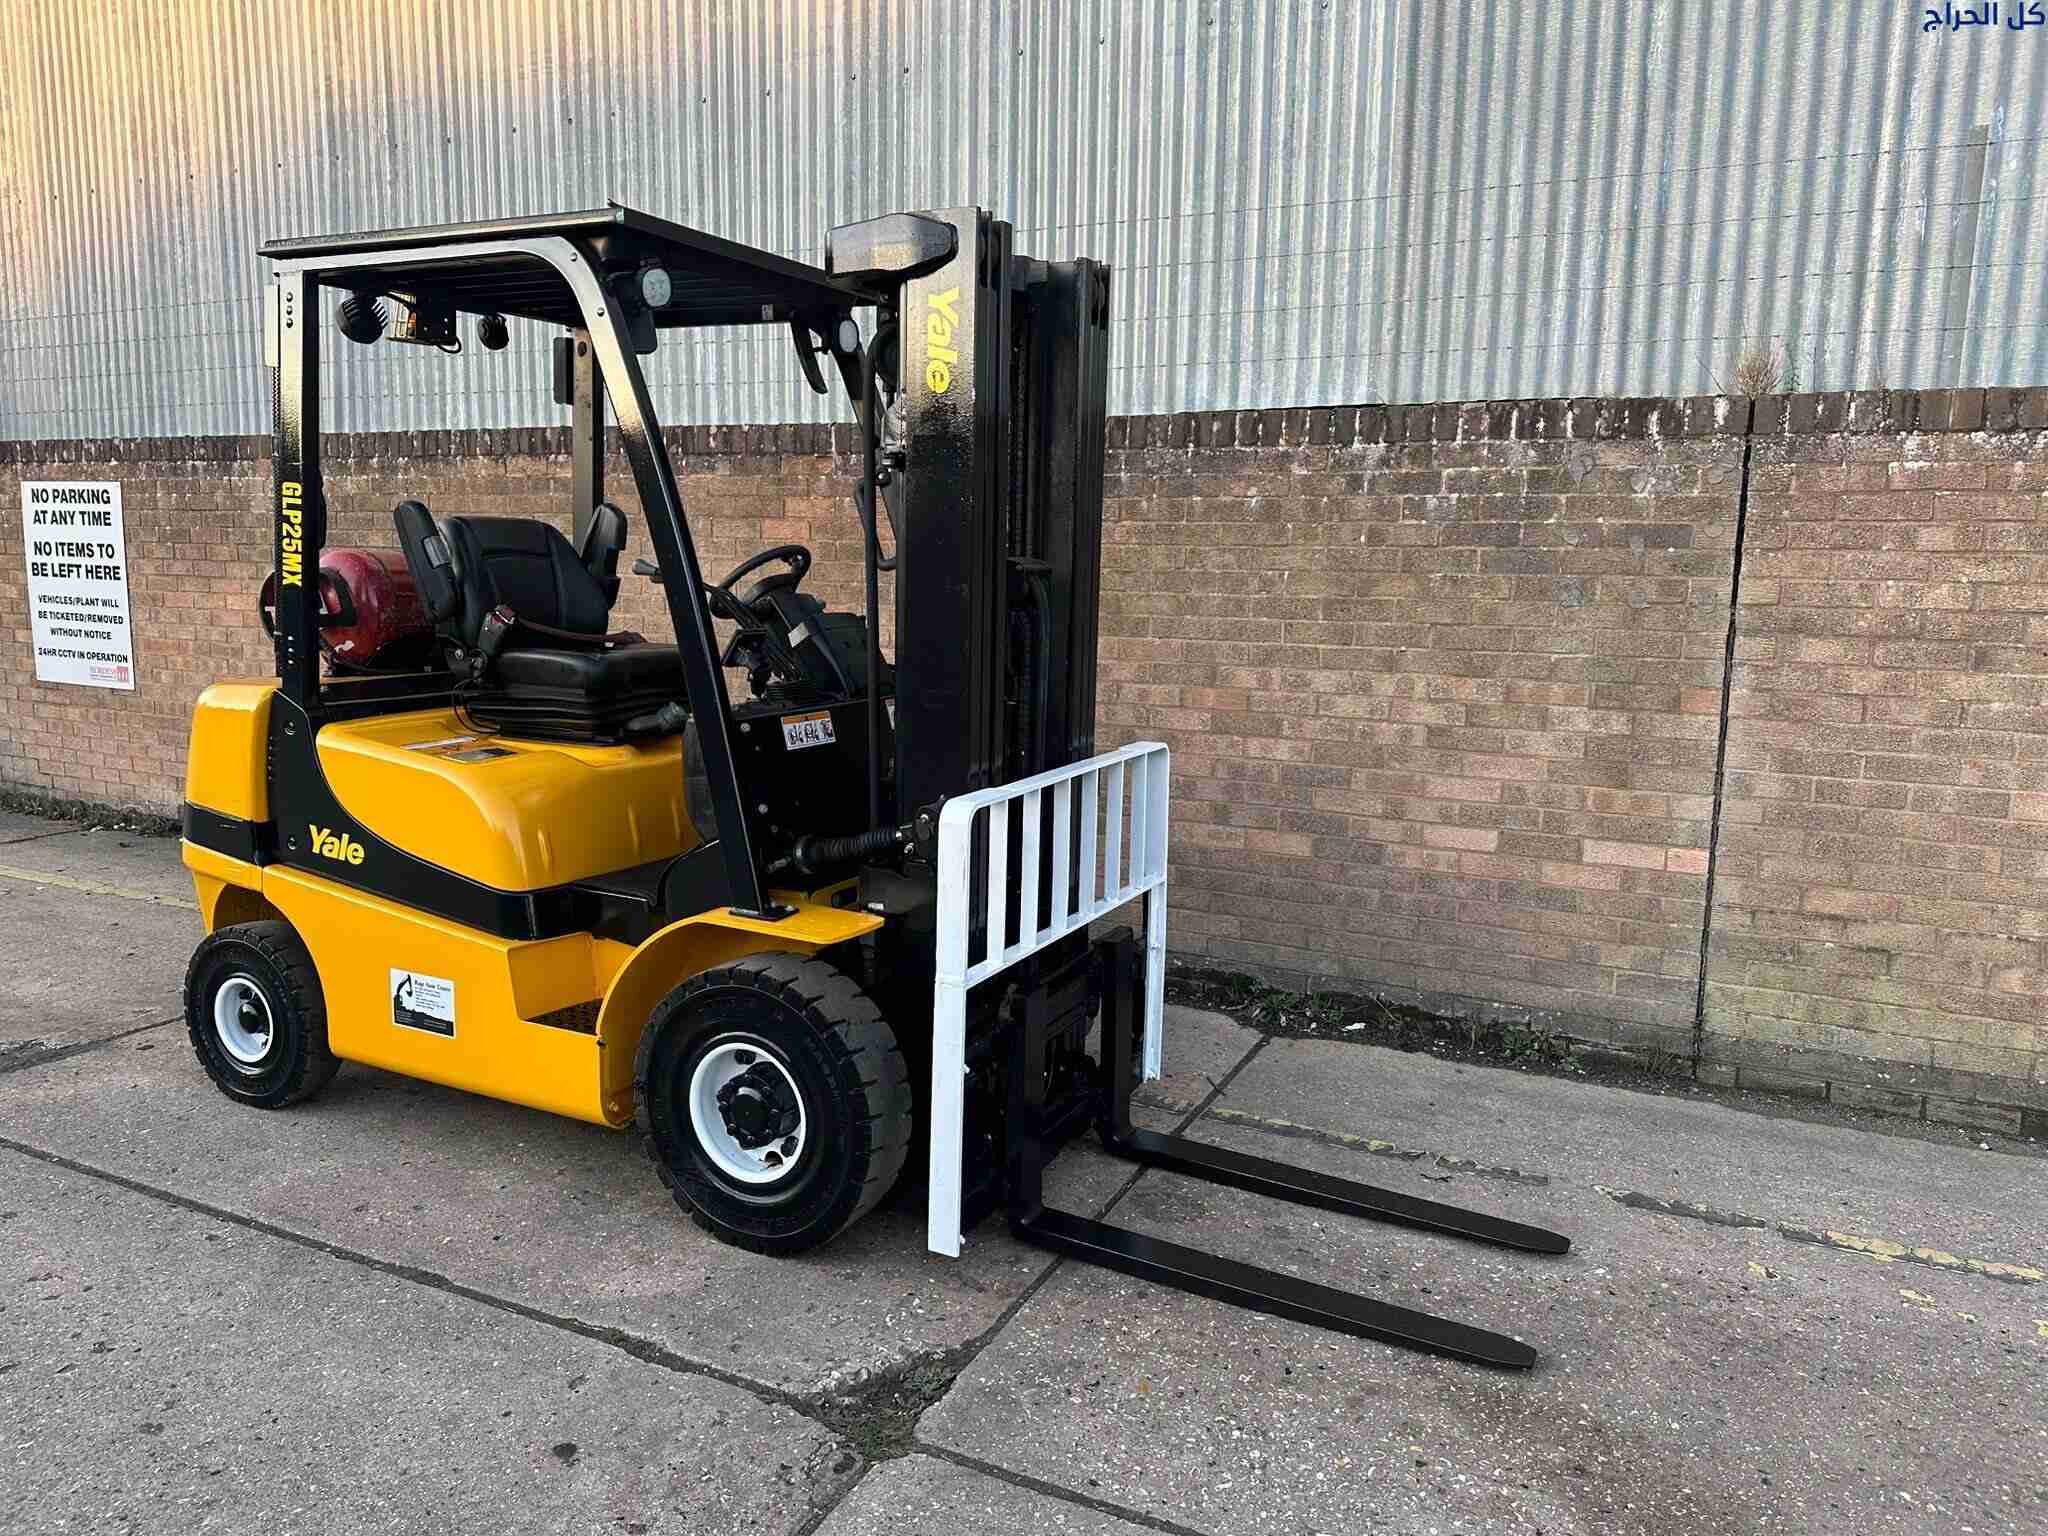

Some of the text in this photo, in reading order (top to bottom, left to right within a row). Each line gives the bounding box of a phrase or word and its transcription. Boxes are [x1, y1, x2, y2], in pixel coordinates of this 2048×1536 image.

[927, 287, 960, 394] Yale
[31, 488, 111, 504] NO PARKING
[33, 510, 112, 527] AT ANY TIME
[281, 481, 303, 587] GLP25MX
[34, 541, 115, 559] NO ITEMS TO
[32, 562, 122, 581] BE LEFT HERE
[38, 595, 119, 608] VEHICLES/PLANT WILL
[38, 611, 124, 625] BE TICKETED/REMOVED
[50, 627, 113, 641] WITHOUT NOTICE
[38, 648, 129, 664] 24HR CCTV IN OPERATION
[309, 824, 365, 865] Yale
